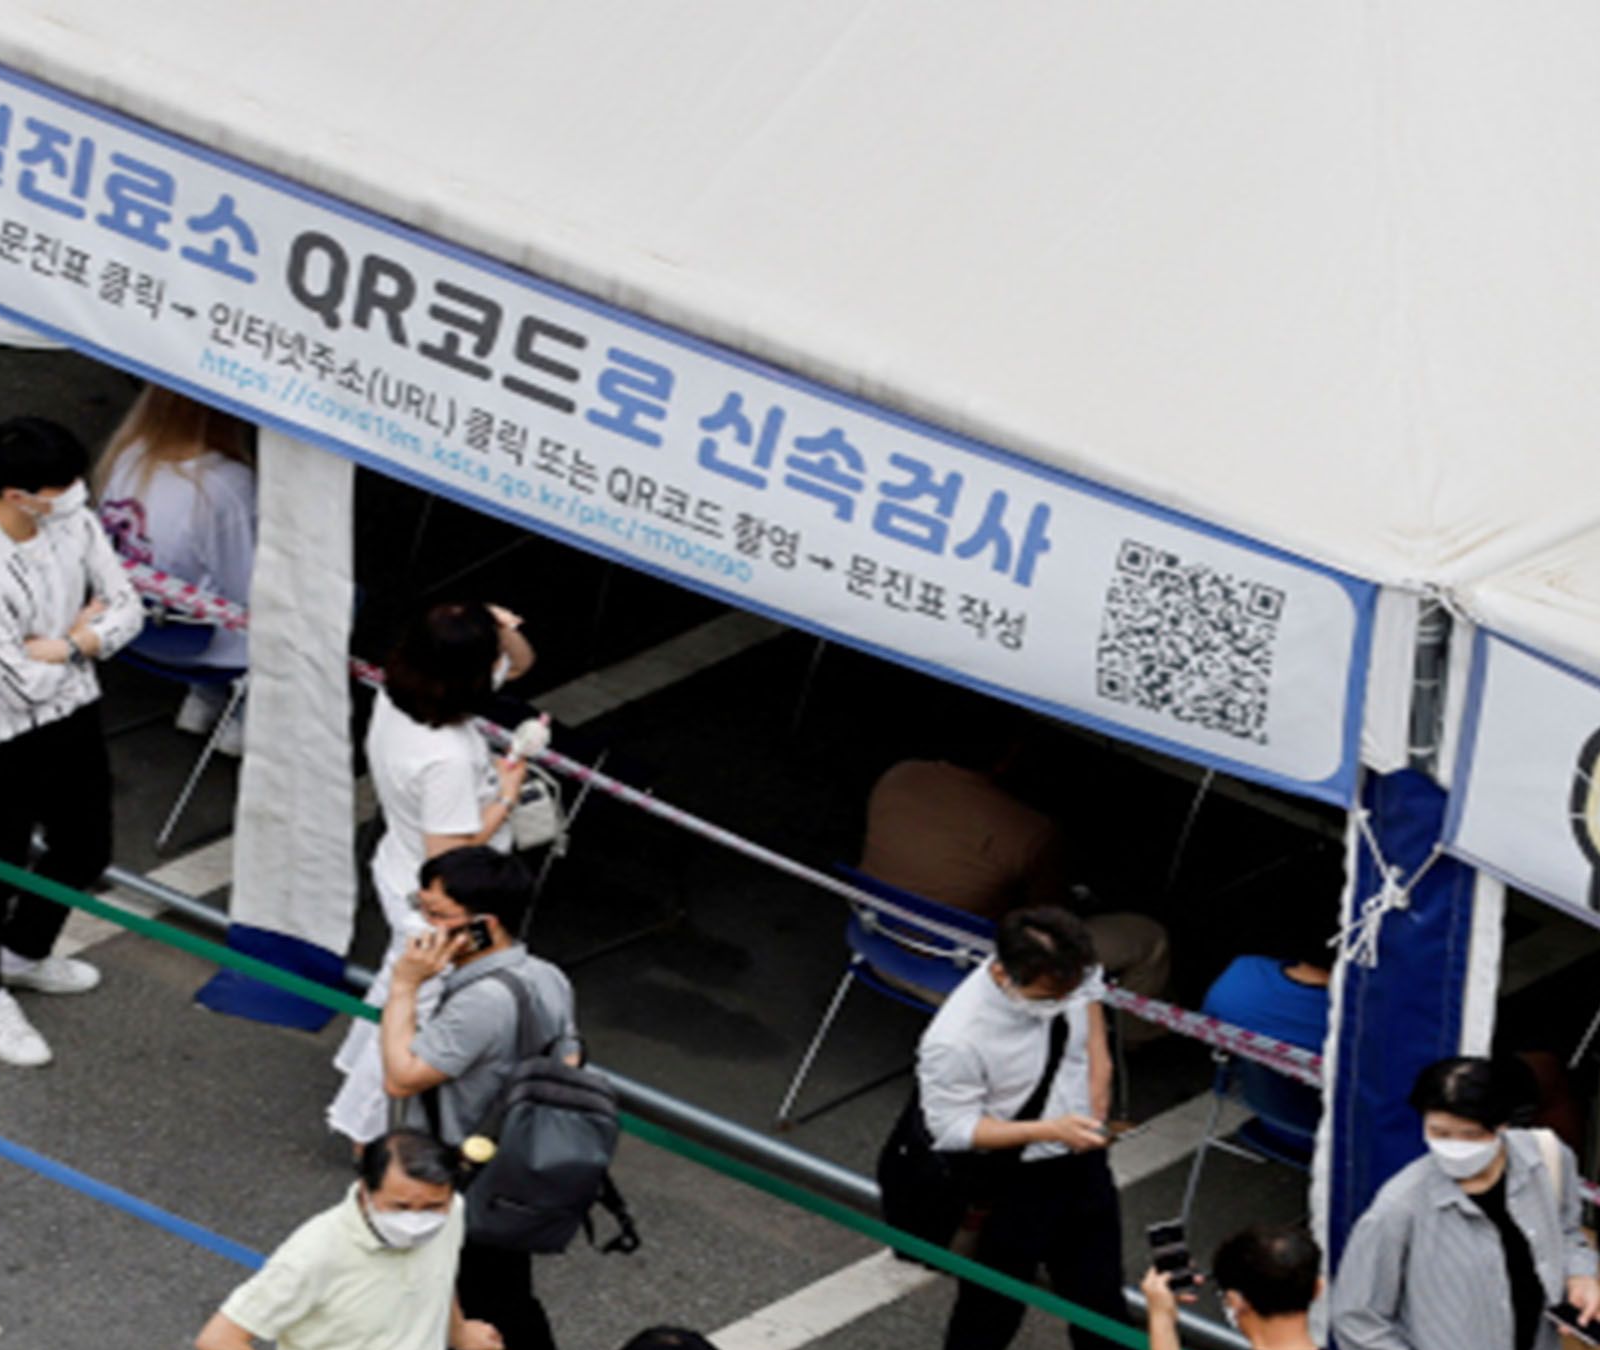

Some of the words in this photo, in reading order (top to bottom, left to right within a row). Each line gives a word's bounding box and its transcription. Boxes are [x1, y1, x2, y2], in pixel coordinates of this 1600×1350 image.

[98, 258, 166, 320] 클릭
[208, 302, 456, 437] 인터넷주소(URL)
[465, 407, 528, 467] 클릭
[535, 442, 599, 494] 또는
[606, 467, 724, 539] QR코드
[732, 513, 800, 570] 촬영
[845, 553, 947, 621] 문진표
[957, 593, 1028, 651] 작성
[285, 231, 675, 448] QR코드로
[699, 391, 1052, 588] 신속검사
